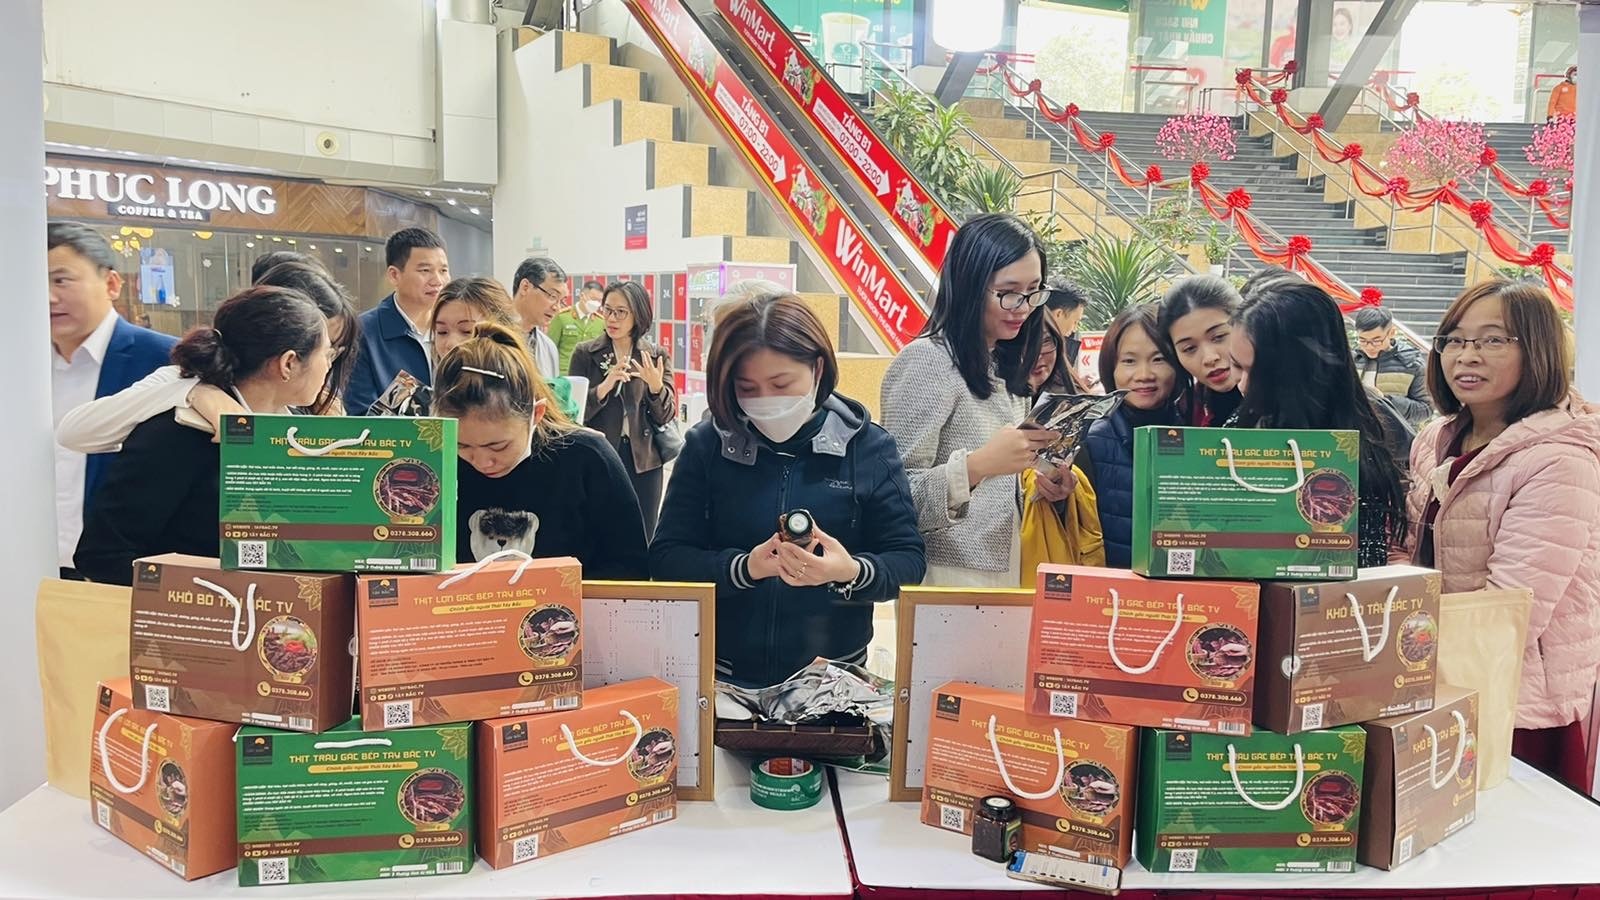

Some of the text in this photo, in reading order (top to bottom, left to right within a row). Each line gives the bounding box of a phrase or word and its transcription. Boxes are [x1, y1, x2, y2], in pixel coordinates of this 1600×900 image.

[728, 0, 777, 52] WinMart
[738, 116, 758, 143] 07:00
[759, 143, 779, 172] 22:00
[839, 131, 859, 158] 07:00
[861, 159, 883, 186] 22:00
[165, 176, 277, 215] LONG
[117, 205, 203, 220] COFFEE & TEA
[835, 218, 909, 333] WinMart
[400, 440, 412, 448] TV
[1319, 450, 1332, 459] TV
[535, 587, 547, 596] TV
[276, 600, 294, 614] TV
[1410, 598, 1424, 609] TV
[1208, 606, 1221, 614] TV
[1079, 740, 1090, 750] TV
[423, 749, 436, 758] TV
[1327, 752, 1338, 761] TV
